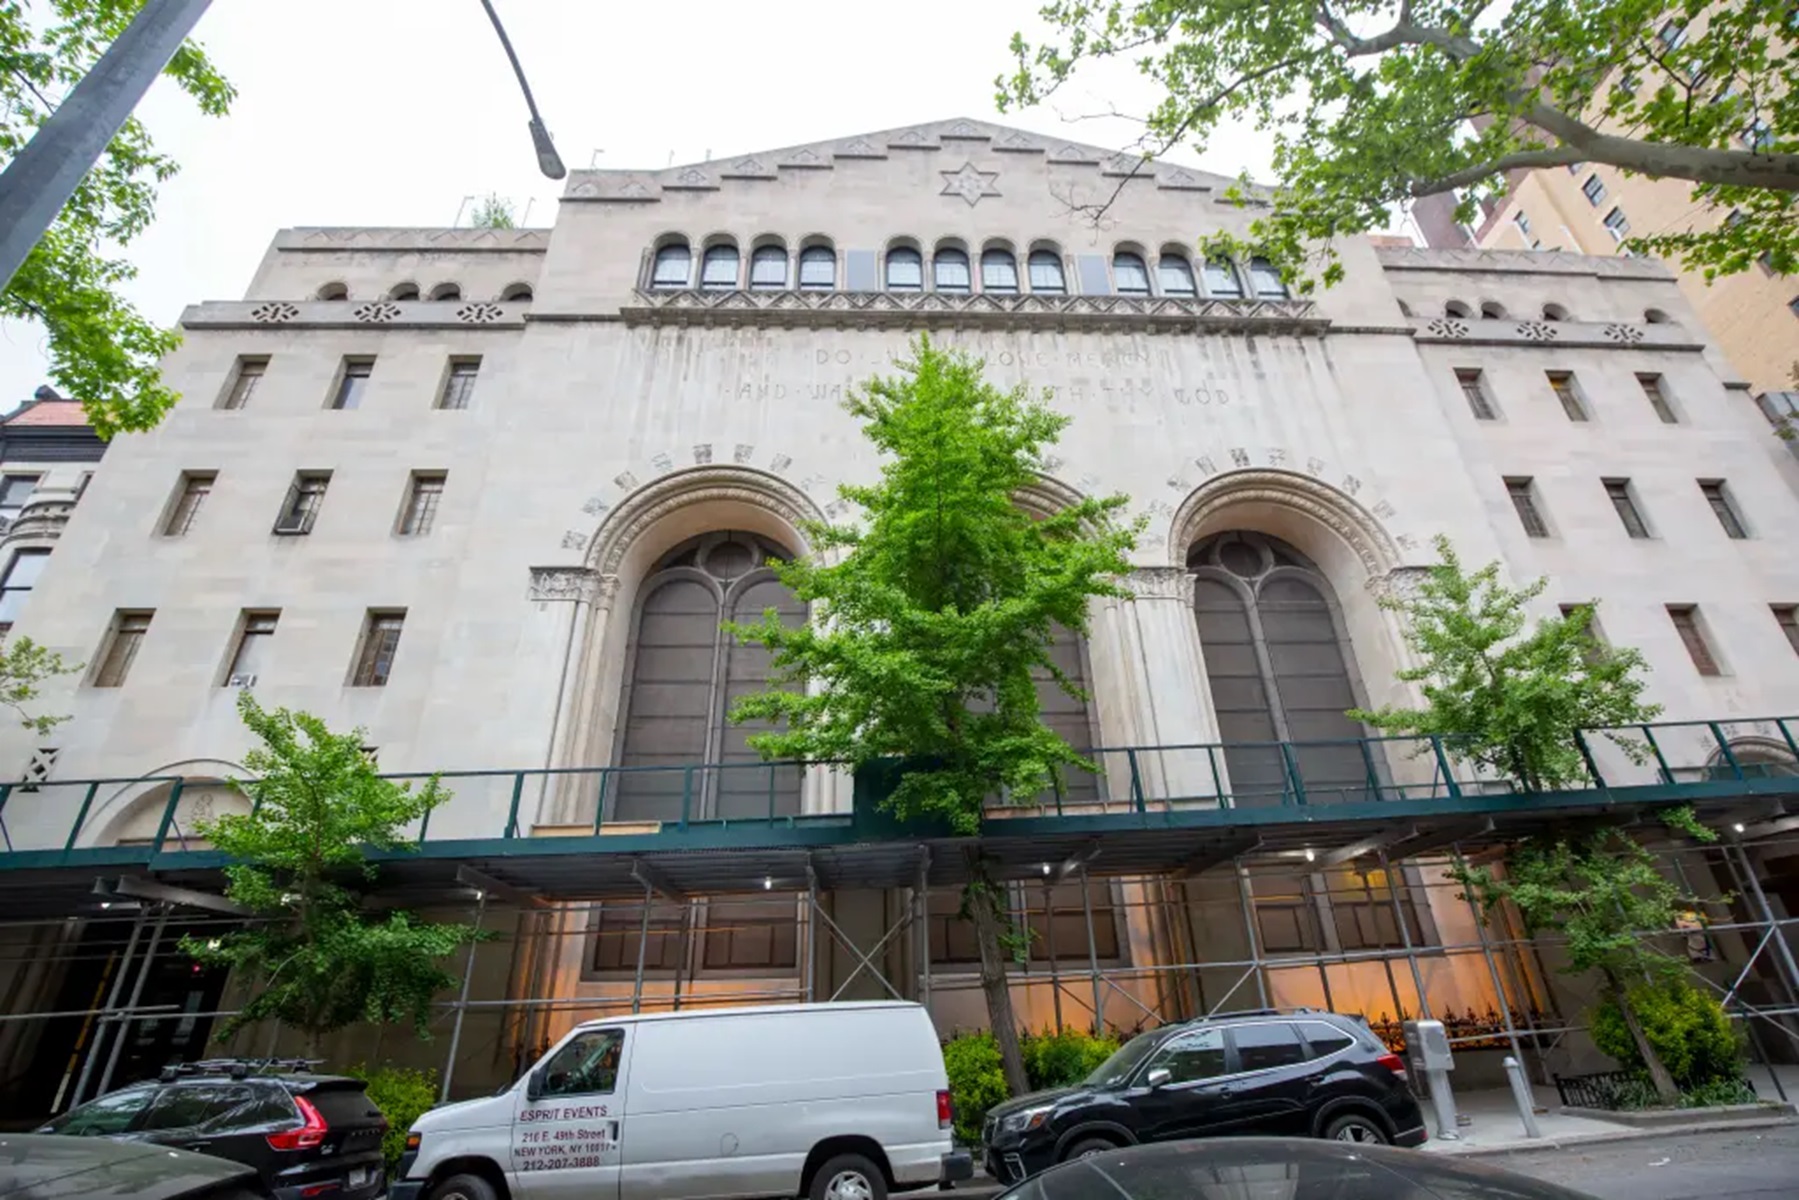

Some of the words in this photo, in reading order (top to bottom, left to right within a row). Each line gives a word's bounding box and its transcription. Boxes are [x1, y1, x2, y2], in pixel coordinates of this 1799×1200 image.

[816, 348, 852, 365] DO
[520, 1108, 560, 1121] ESPRIT
[563, 1105, 608, 1118] EVENTS
[553, 1129, 575, 1140] 49th
[577, 1128, 606, 1139] Street
[514, 1146, 537, 1157] NEW
[569, 1144, 582, 1153] NY
